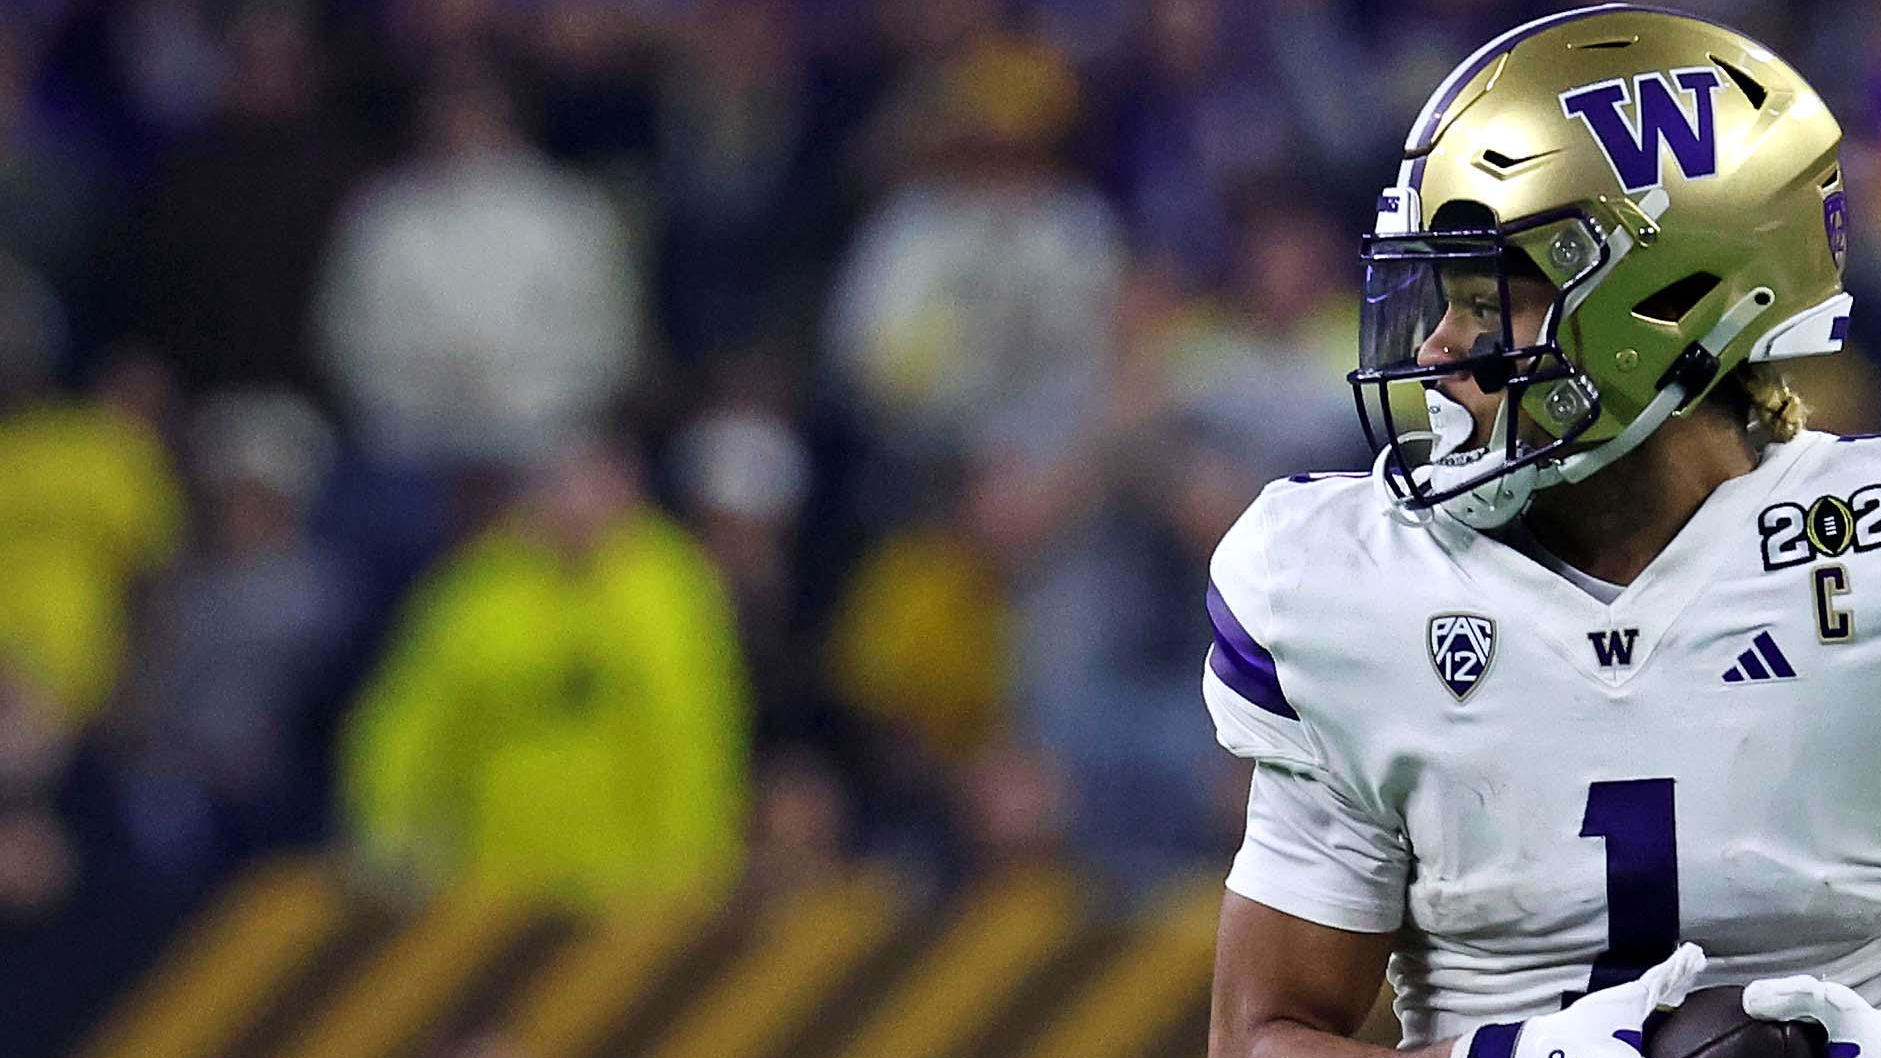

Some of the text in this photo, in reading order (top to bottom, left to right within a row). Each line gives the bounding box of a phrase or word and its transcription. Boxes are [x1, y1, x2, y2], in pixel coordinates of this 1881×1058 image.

[1559, 67, 1722, 193] W
[1812, 562, 1854, 643] C
[1431, 615, 1493, 665] PAC
[1445, 651, 1478, 682] 12
[1587, 628, 1640, 667] W
[1560, 777, 1680, 1011] 1
